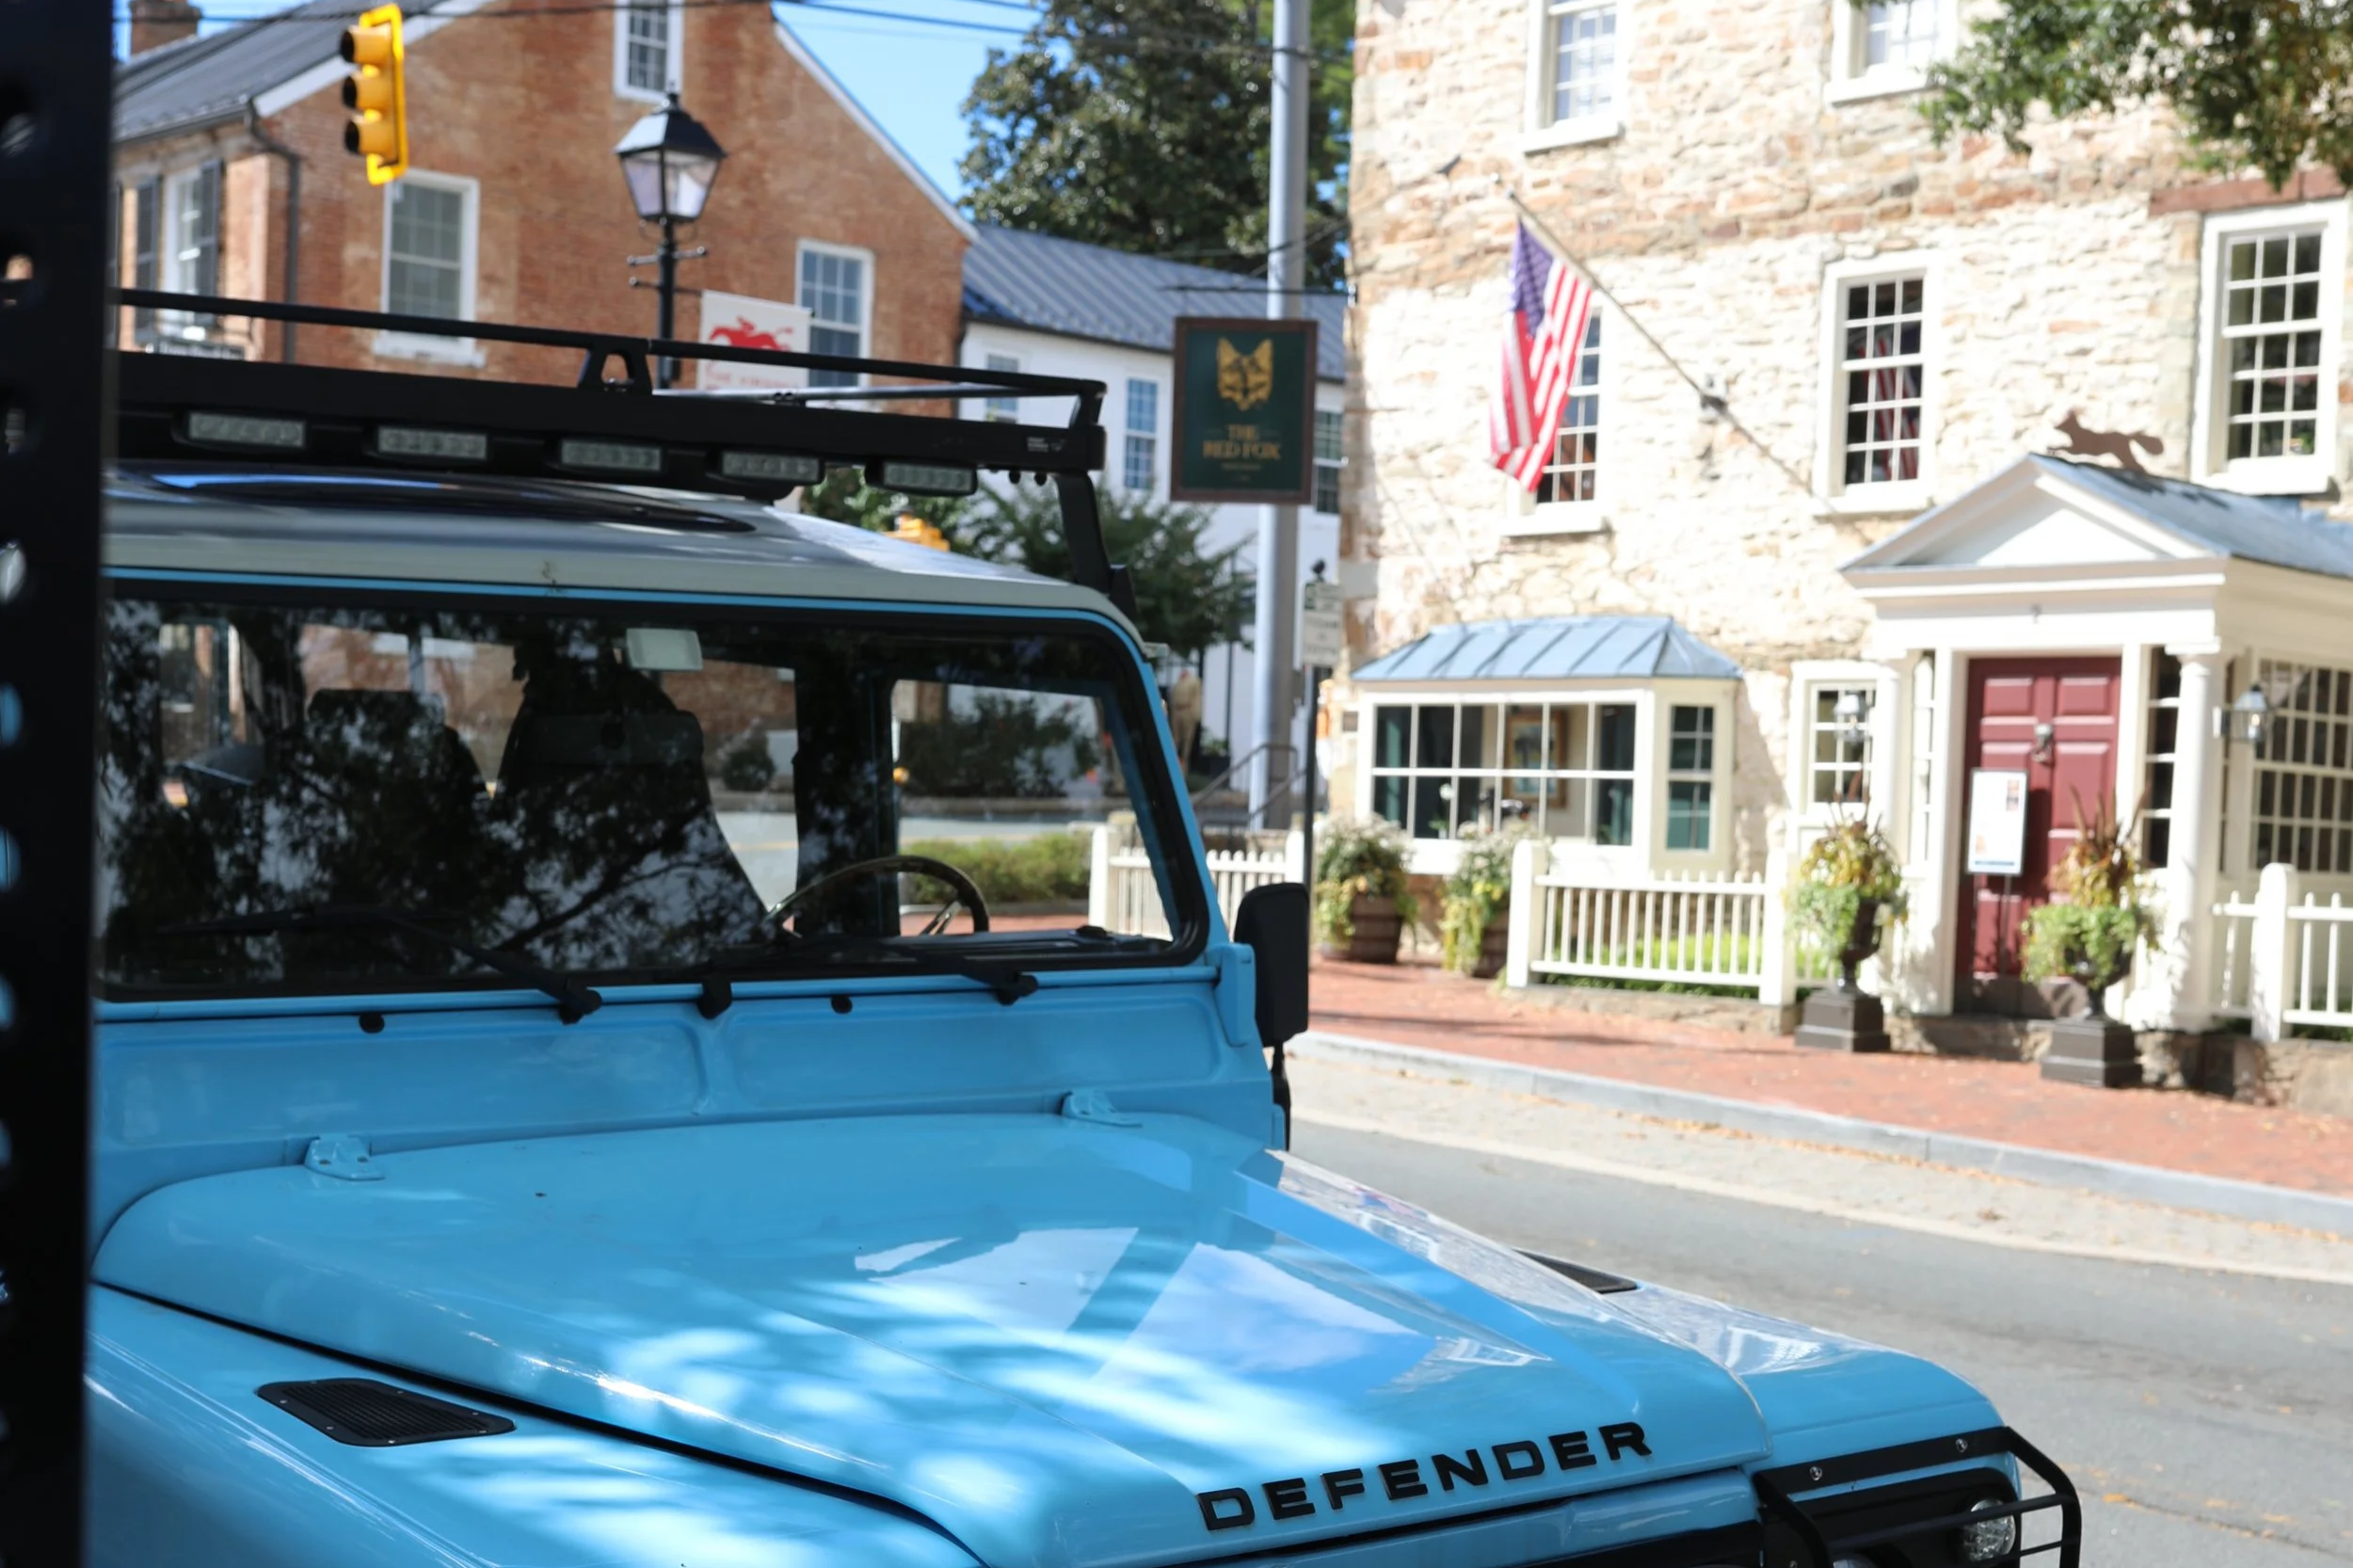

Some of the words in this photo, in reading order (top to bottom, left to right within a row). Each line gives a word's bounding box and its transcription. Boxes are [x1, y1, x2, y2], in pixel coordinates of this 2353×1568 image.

[1226, 424, 1259, 440] THE
[1203, 440, 1241, 458] RED
[1242, 441, 1281, 460] FOX
[1196, 1421, 1653, 1531] DEFENDER
